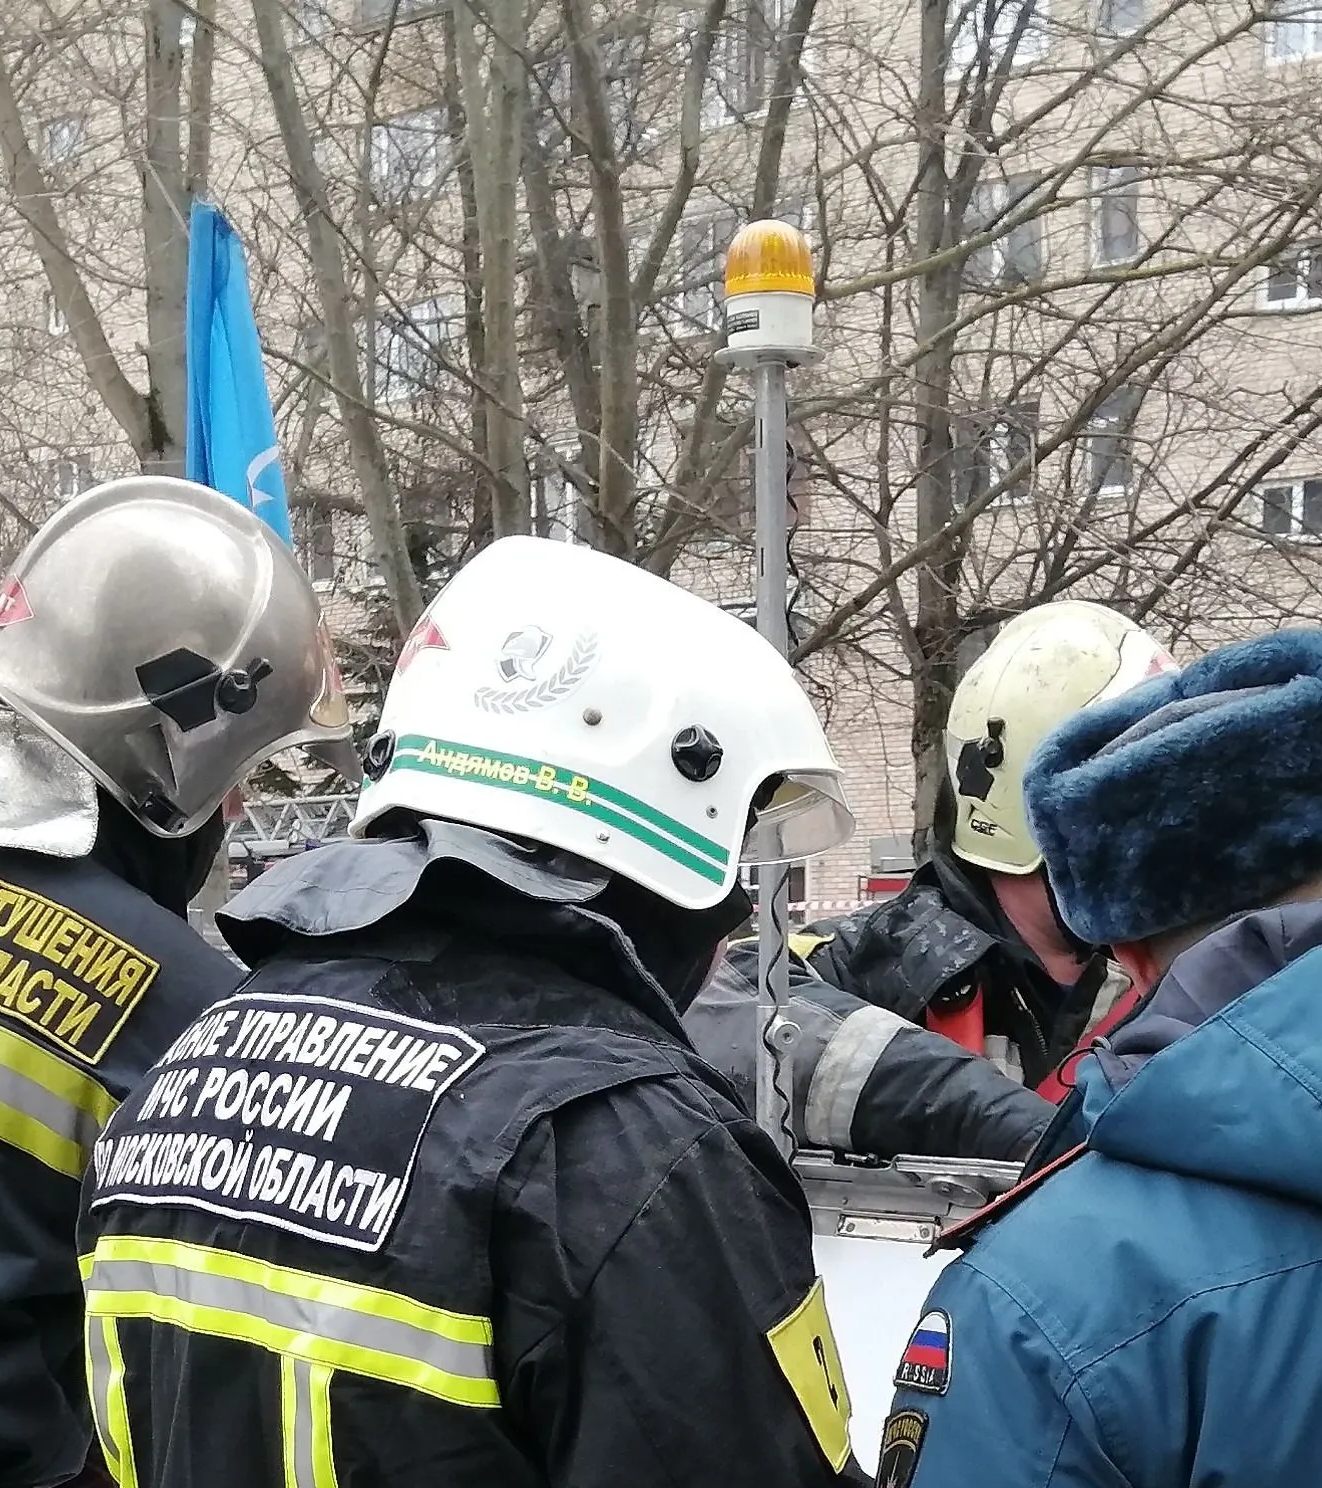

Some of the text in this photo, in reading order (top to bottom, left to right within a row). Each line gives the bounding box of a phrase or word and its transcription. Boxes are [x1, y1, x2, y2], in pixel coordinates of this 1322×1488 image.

[225, 1009, 462, 1092] УПРАВЛЕНИЕ
[137, 1067, 353, 1142] МЧС РОССИИ
[105, 1129, 254, 1198] МОСКОВСКОЙ
[248, 1144, 401, 1234] ОБЛАСТИ
